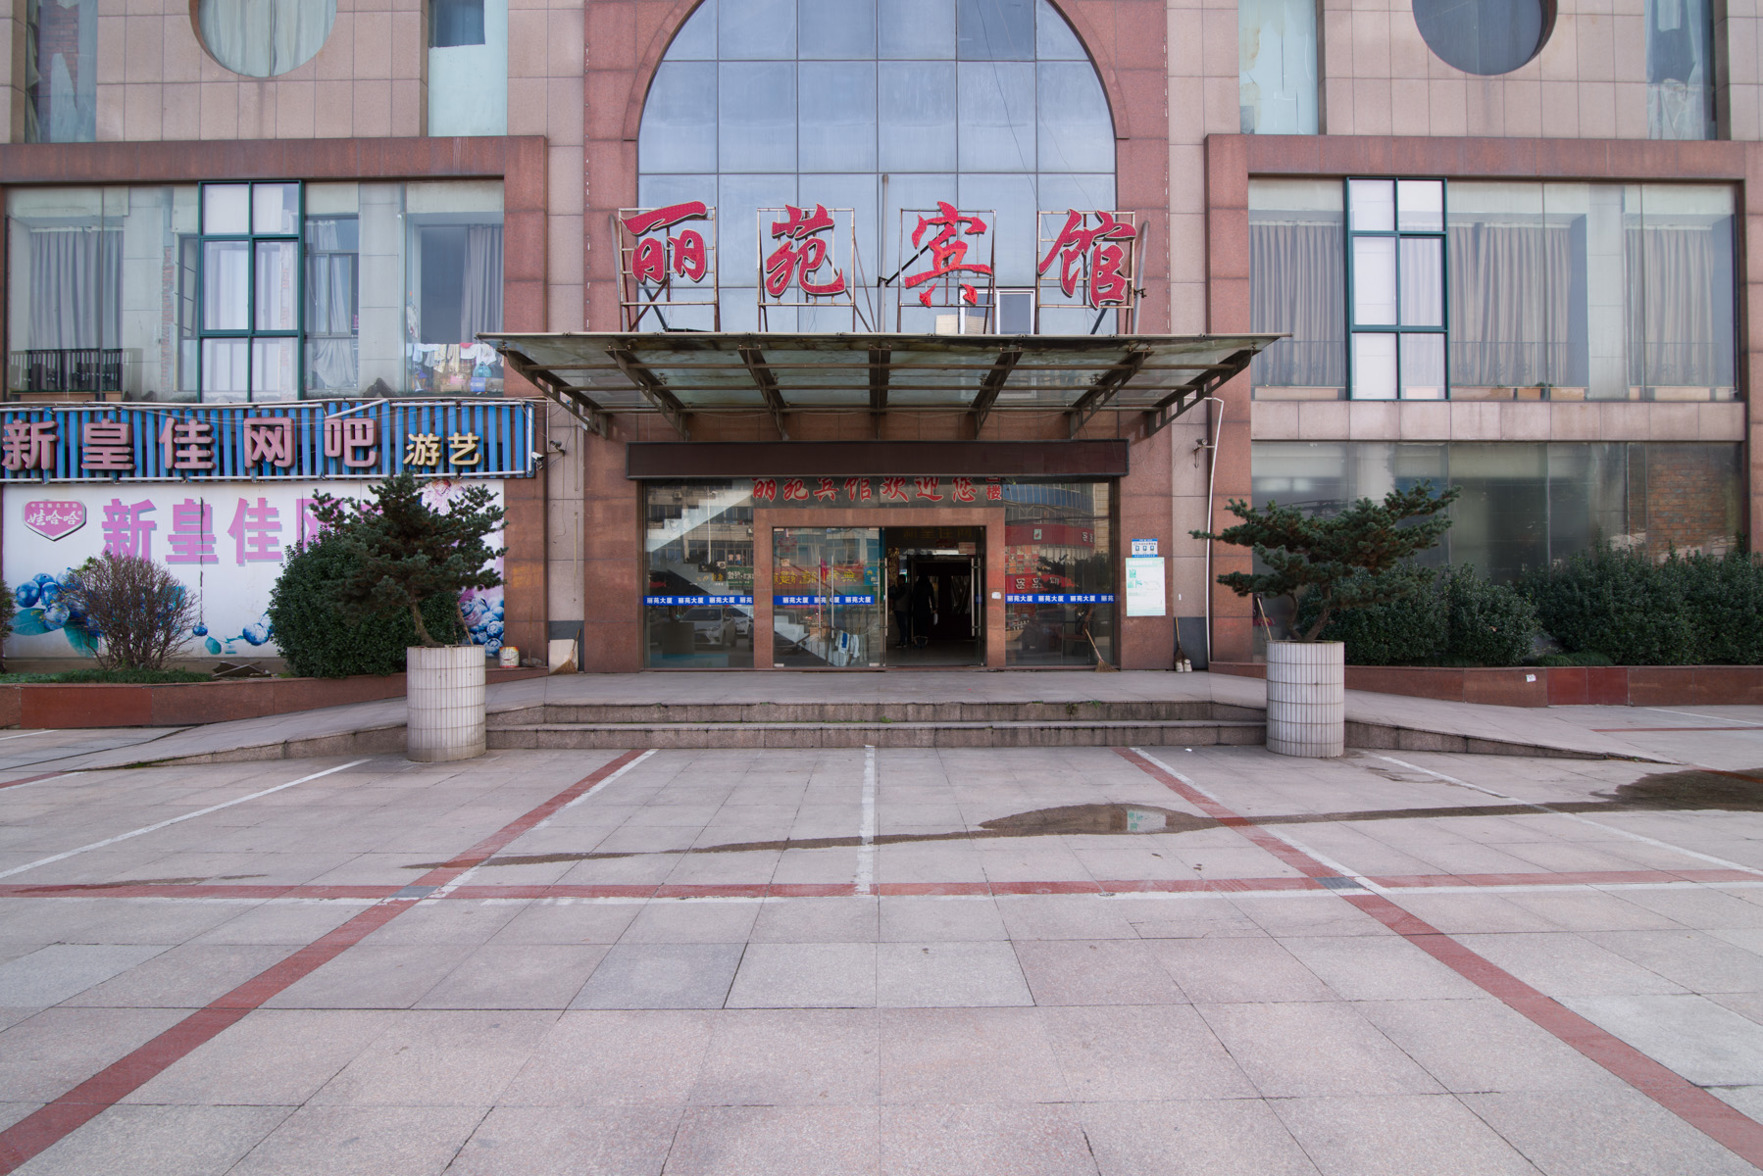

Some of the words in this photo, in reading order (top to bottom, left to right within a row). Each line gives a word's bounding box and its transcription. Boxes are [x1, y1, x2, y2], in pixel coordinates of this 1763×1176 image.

[620, 200, 1137, 311] 丽苑宾馆
[1, 417, 378, 471] 新皇佳网吧
[403, 431, 481, 467] 游艺
[27, 509, 80, 526] 娃哈哈
